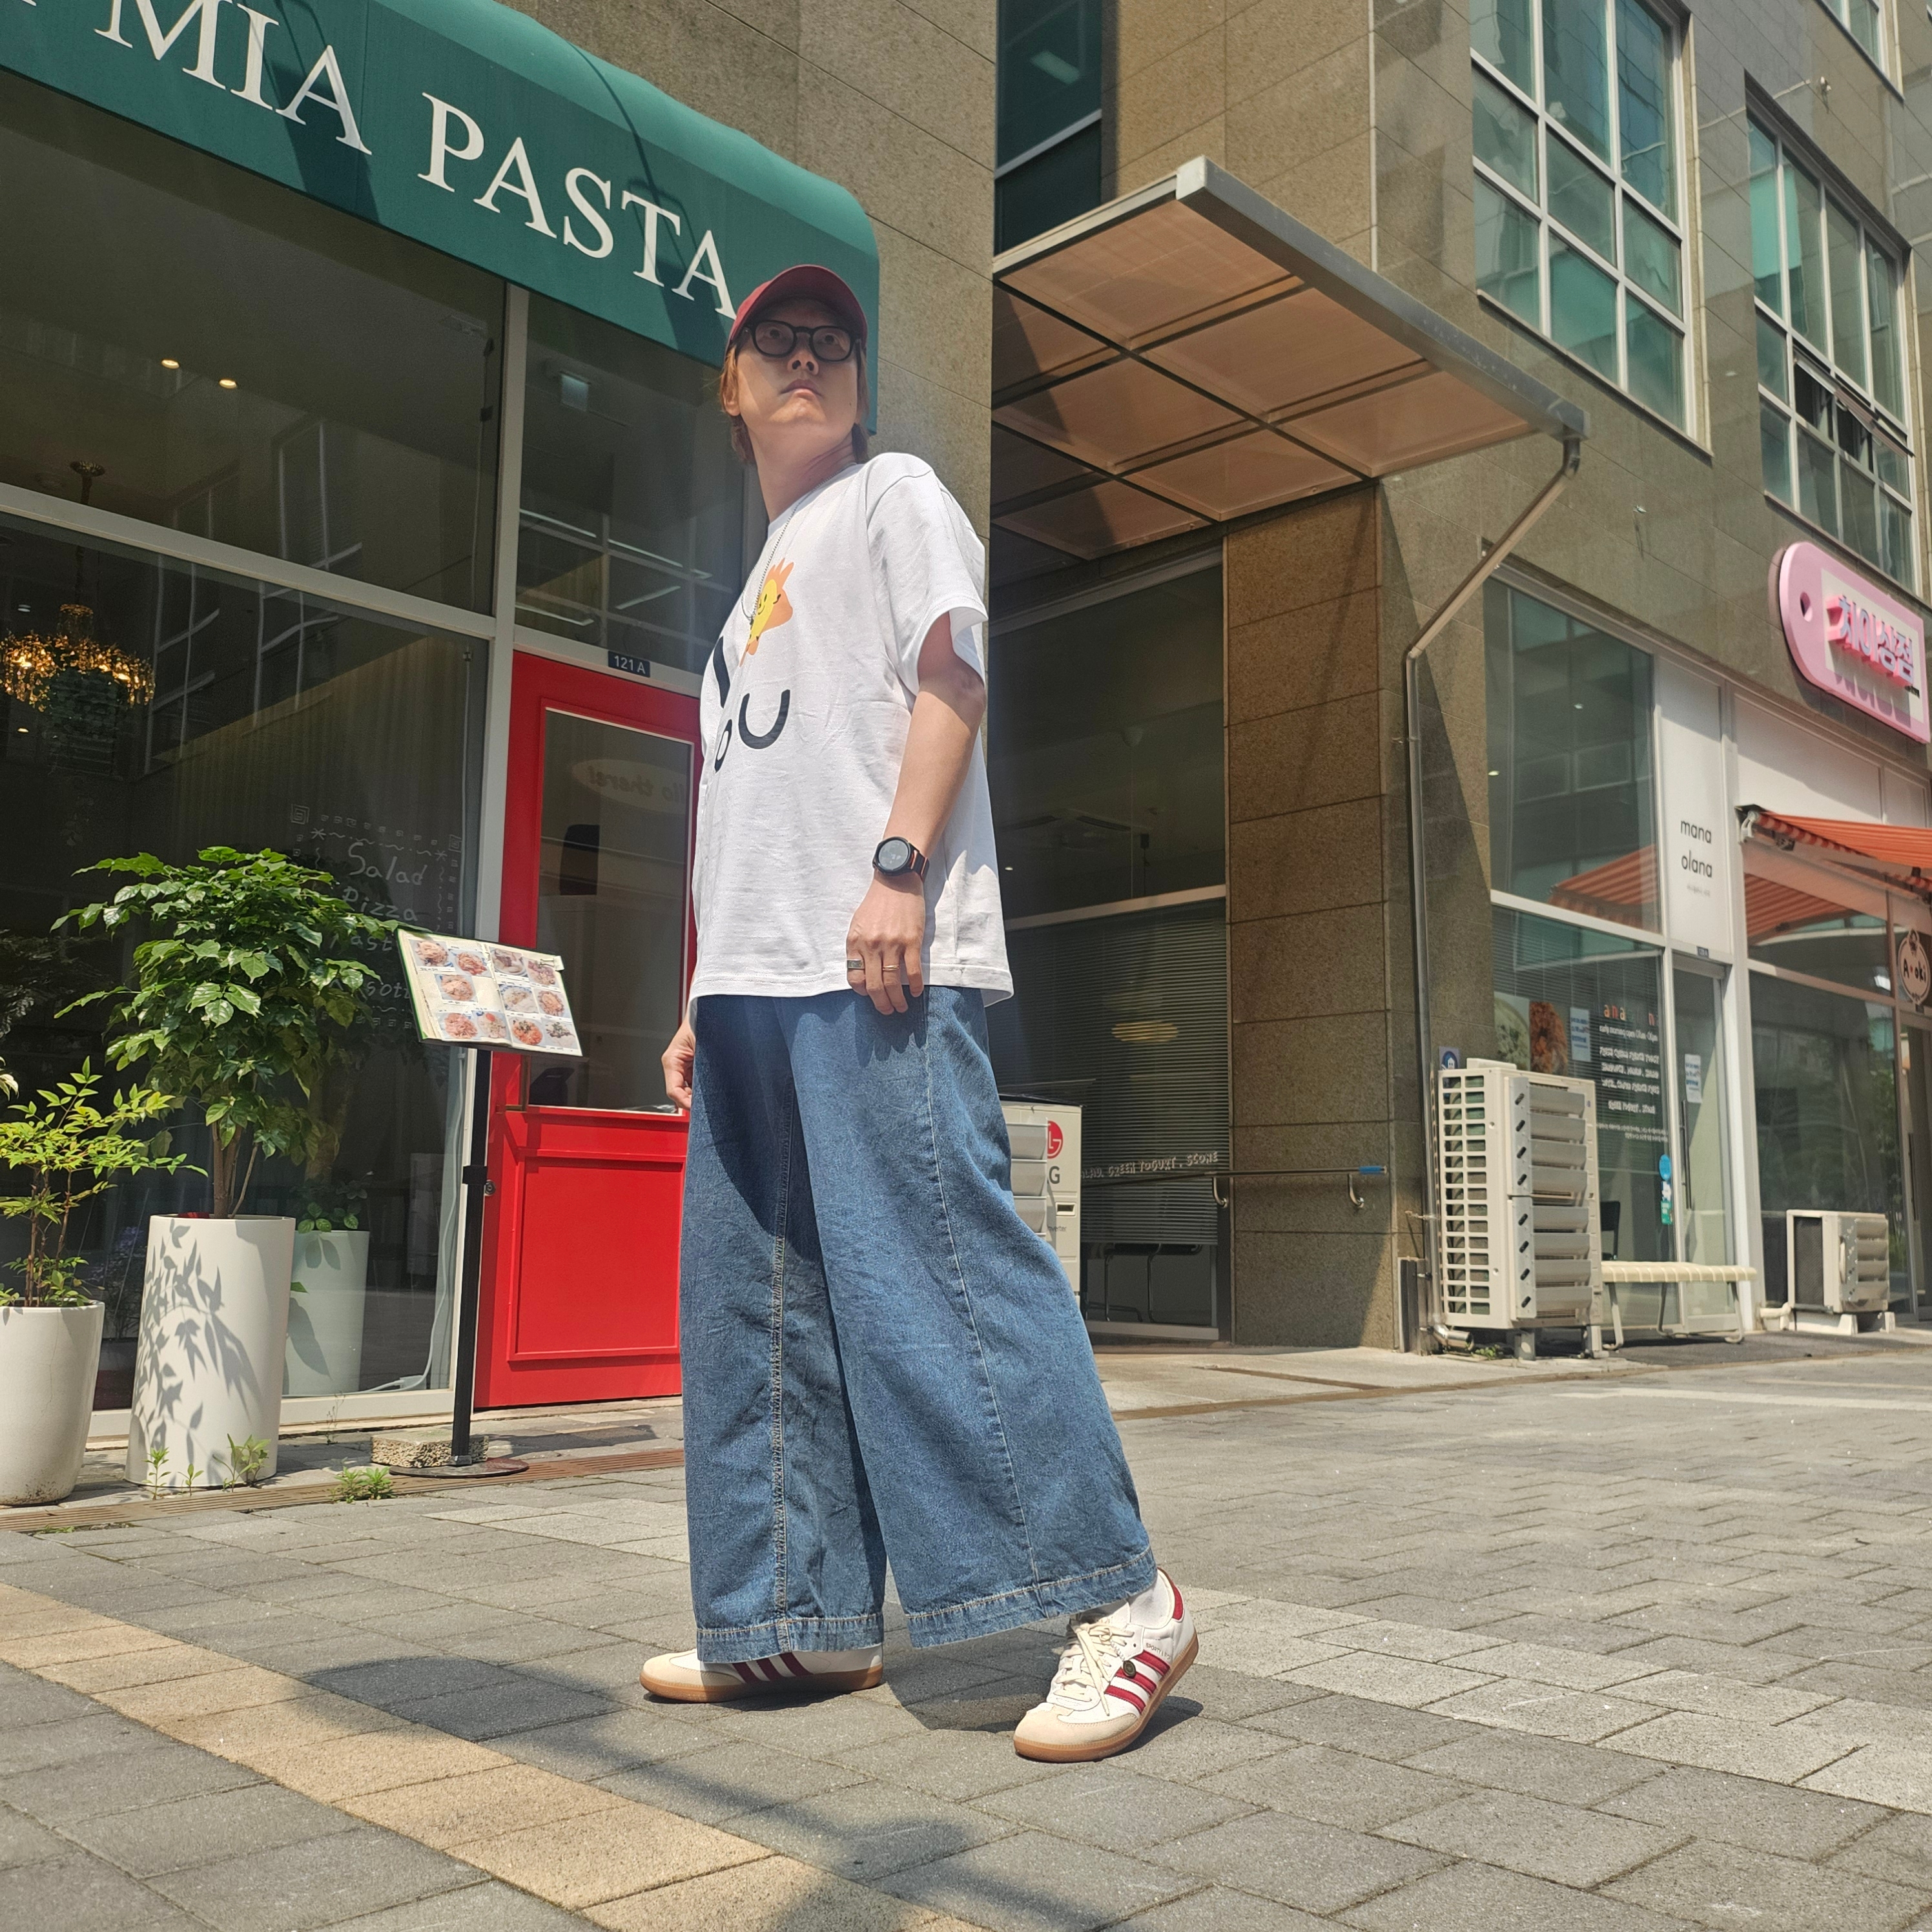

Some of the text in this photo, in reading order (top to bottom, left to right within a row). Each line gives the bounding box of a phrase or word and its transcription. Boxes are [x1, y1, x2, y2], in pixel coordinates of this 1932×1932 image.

[94, 0, 736, 320] MIA PASTA
[1681, 820, 1712, 844] mana
[348, 842, 428, 885] Salad
[1681, 849, 1712, 878] olana
[342, 885, 418, 922] Pizza
